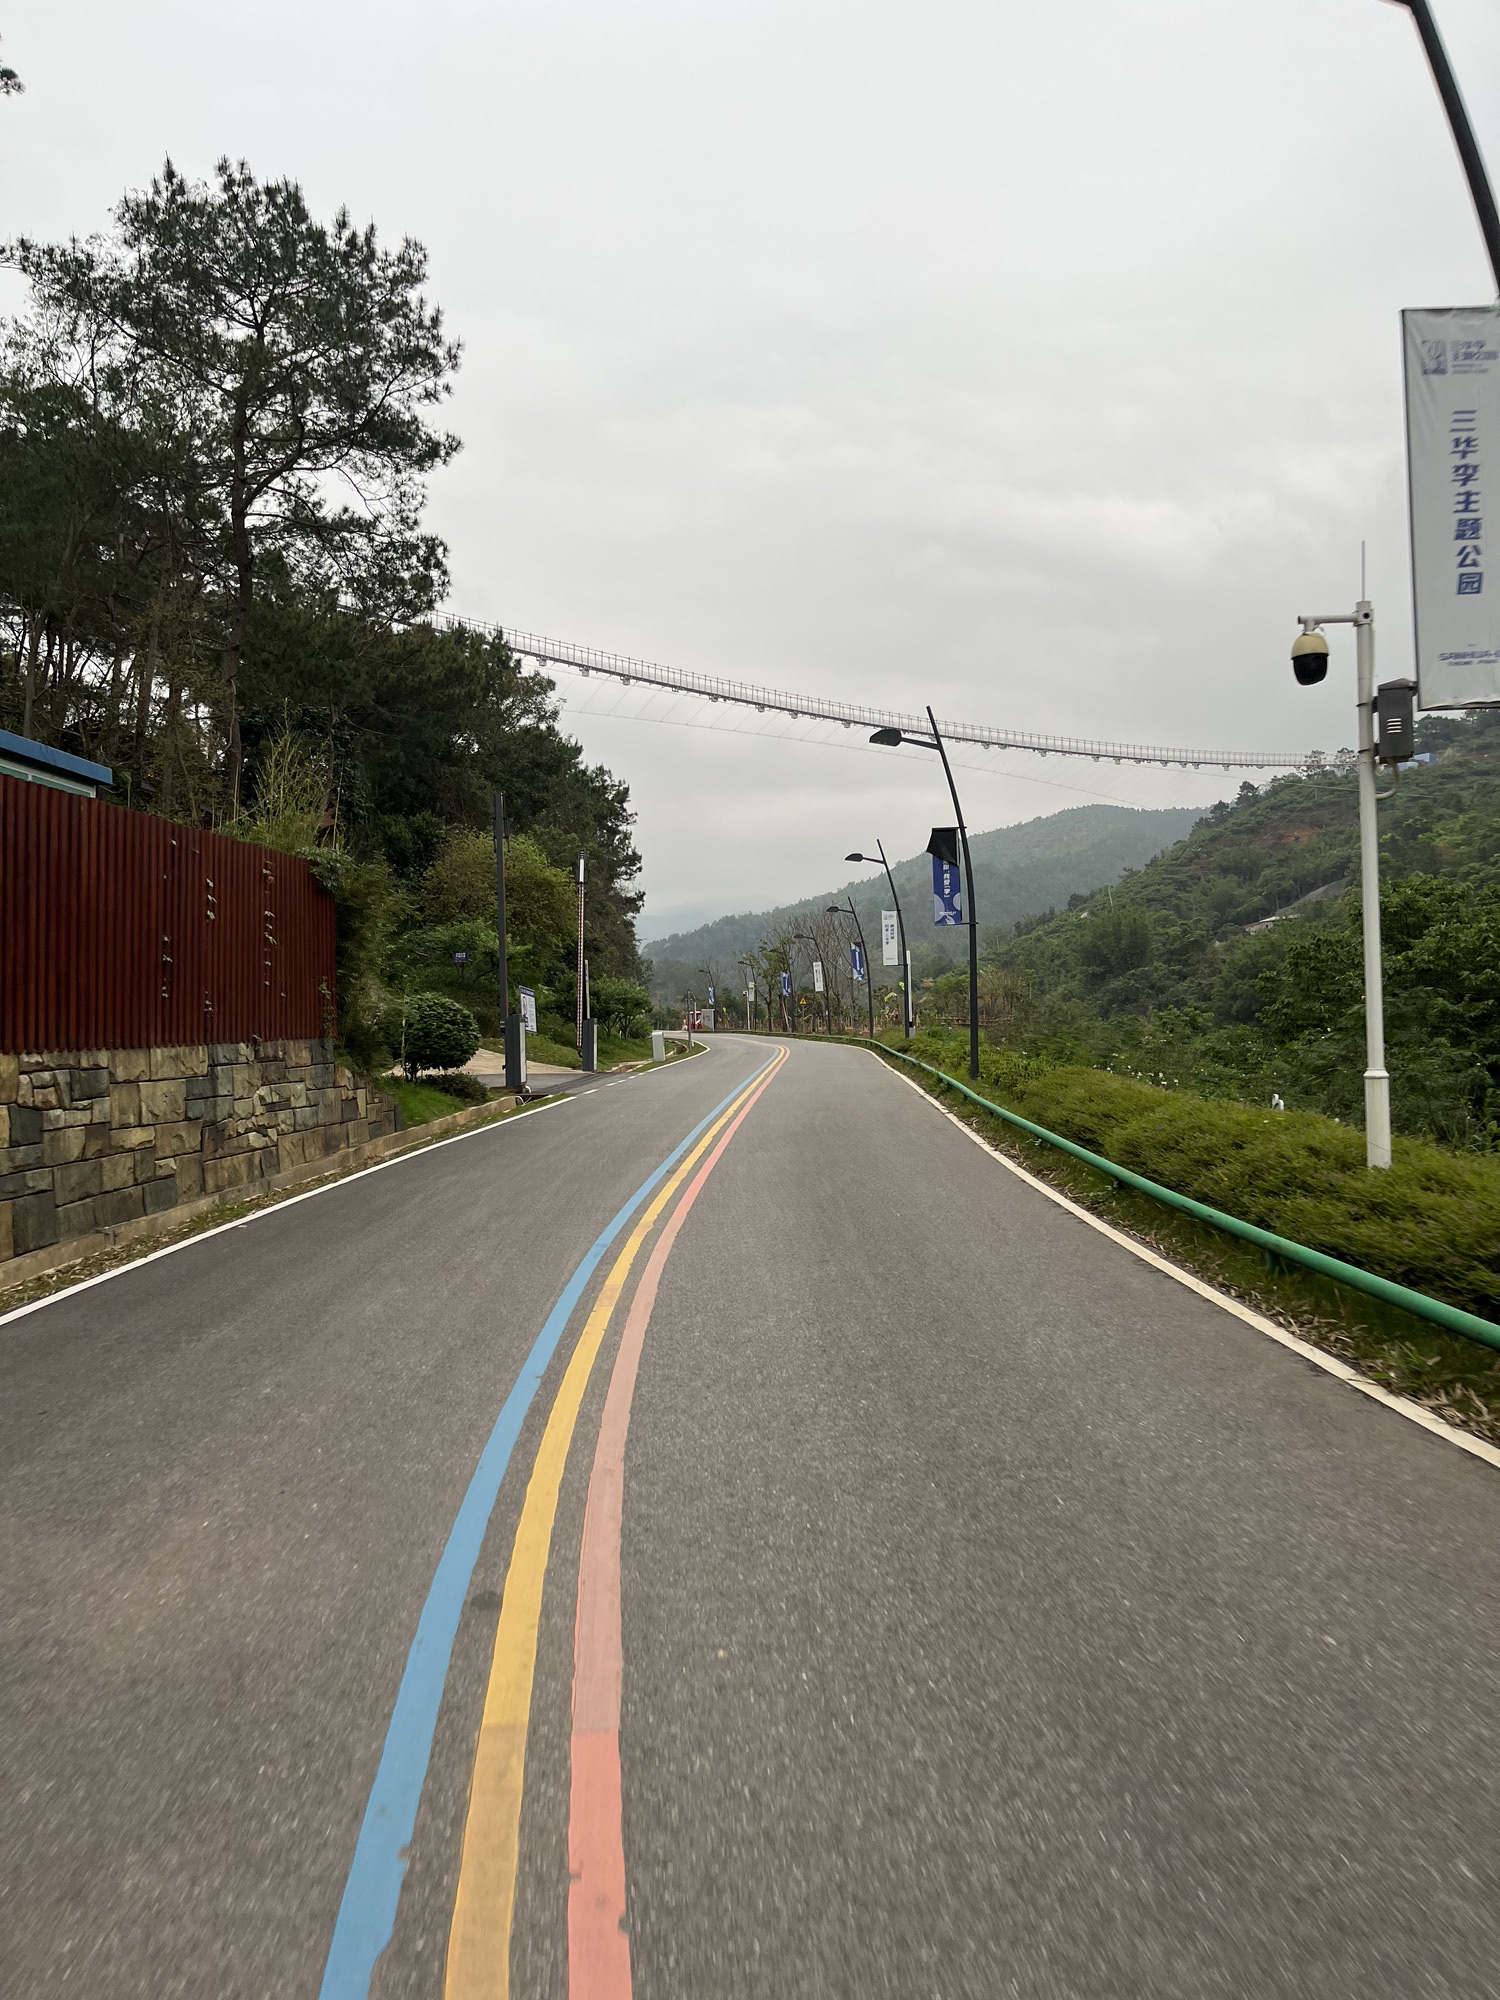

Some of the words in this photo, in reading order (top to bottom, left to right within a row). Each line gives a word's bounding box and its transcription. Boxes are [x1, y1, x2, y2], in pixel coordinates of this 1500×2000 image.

[1449, 409, 1484, 596] 三华李主题公园
